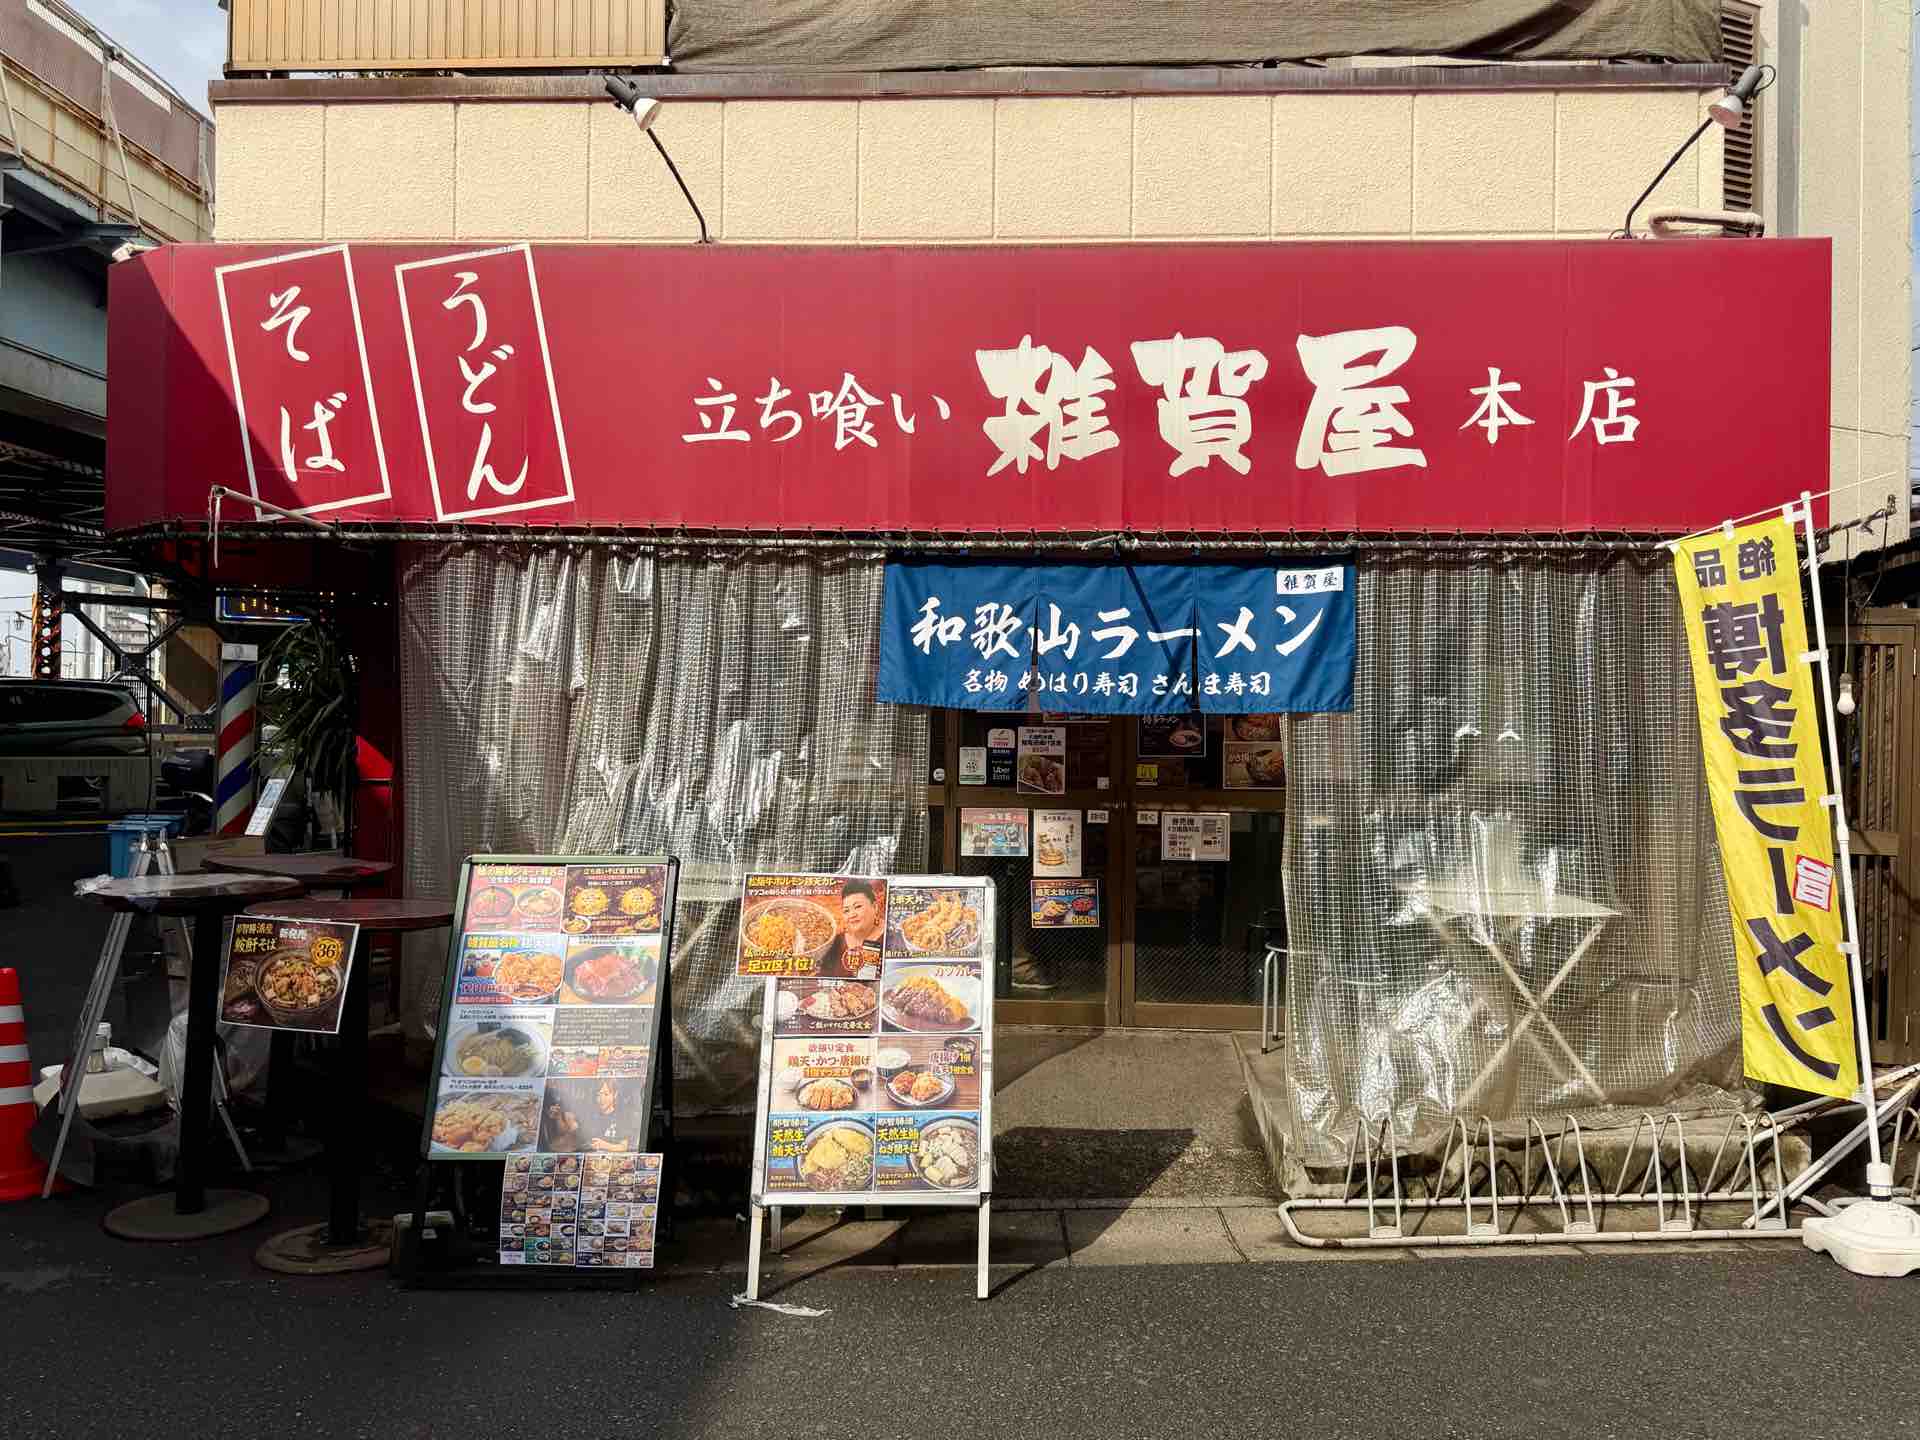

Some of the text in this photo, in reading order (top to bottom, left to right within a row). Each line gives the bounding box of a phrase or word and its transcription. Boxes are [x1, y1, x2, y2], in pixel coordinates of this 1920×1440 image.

[261, 285, 348, 482] そば
[442, 271, 529, 501] うどん
[681, 326, 1641, 477] 立ち喰い 雑賀屋 本店
[1283, 572, 1338, 591] 雑賀屋
[910, 597, 1324, 661] 和歌山ラーメン
[962, 669, 1271, 698] 名物 めはり寿司 さんま寿司
[318, 943, 337, 958] 36
